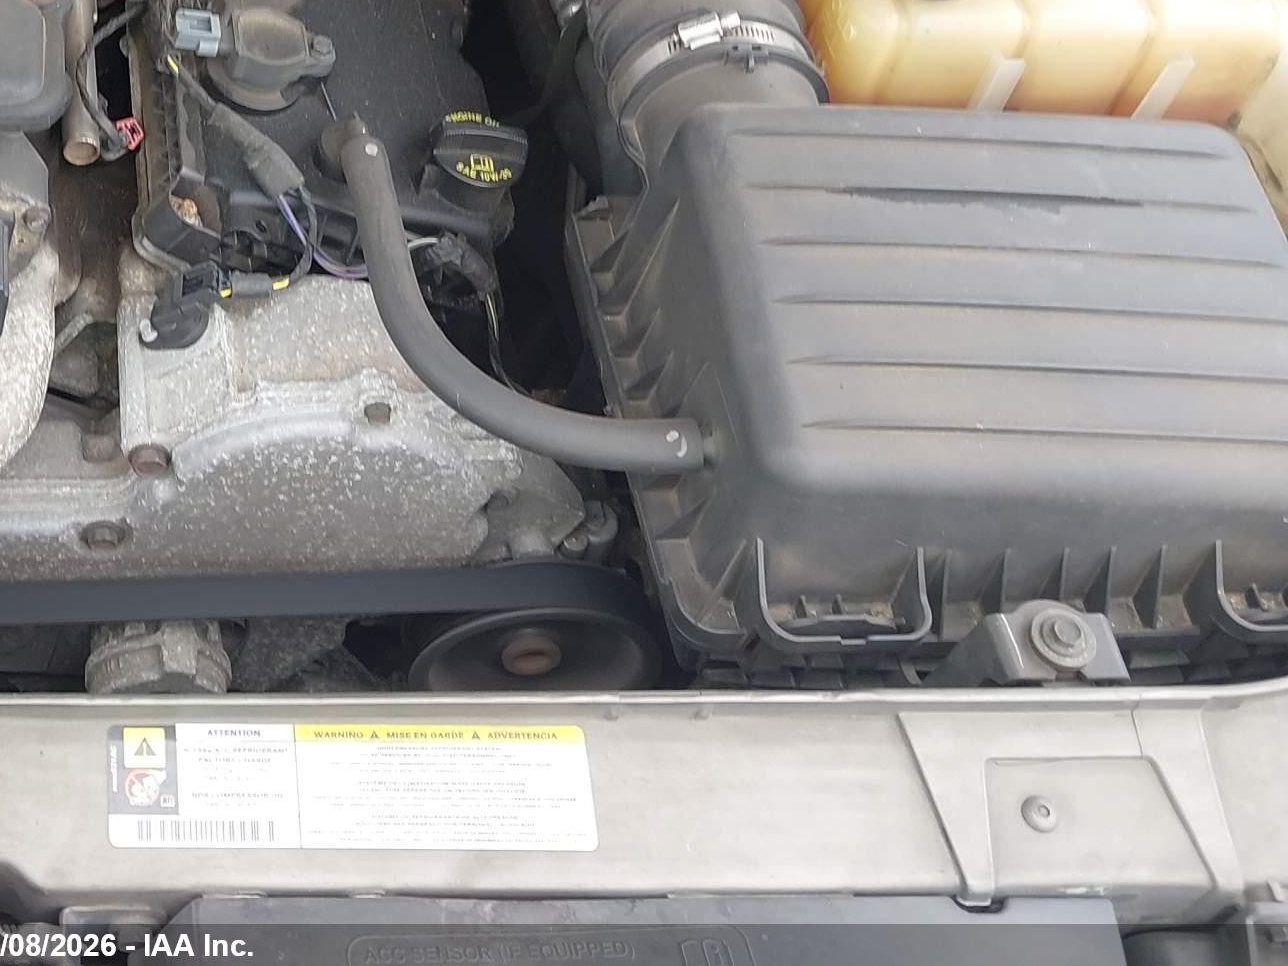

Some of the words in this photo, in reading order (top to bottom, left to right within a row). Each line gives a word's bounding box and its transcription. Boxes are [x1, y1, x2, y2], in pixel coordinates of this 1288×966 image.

[207, 729, 261, 738] ATTENTION
[313, 731, 364, 740] WARNING
[386, 731, 412, 740] MISE
[413, 731, 428, 740] EN
[430, 731, 465, 740] GARDE
[486, 731, 558, 740] ADVERTENCIA
